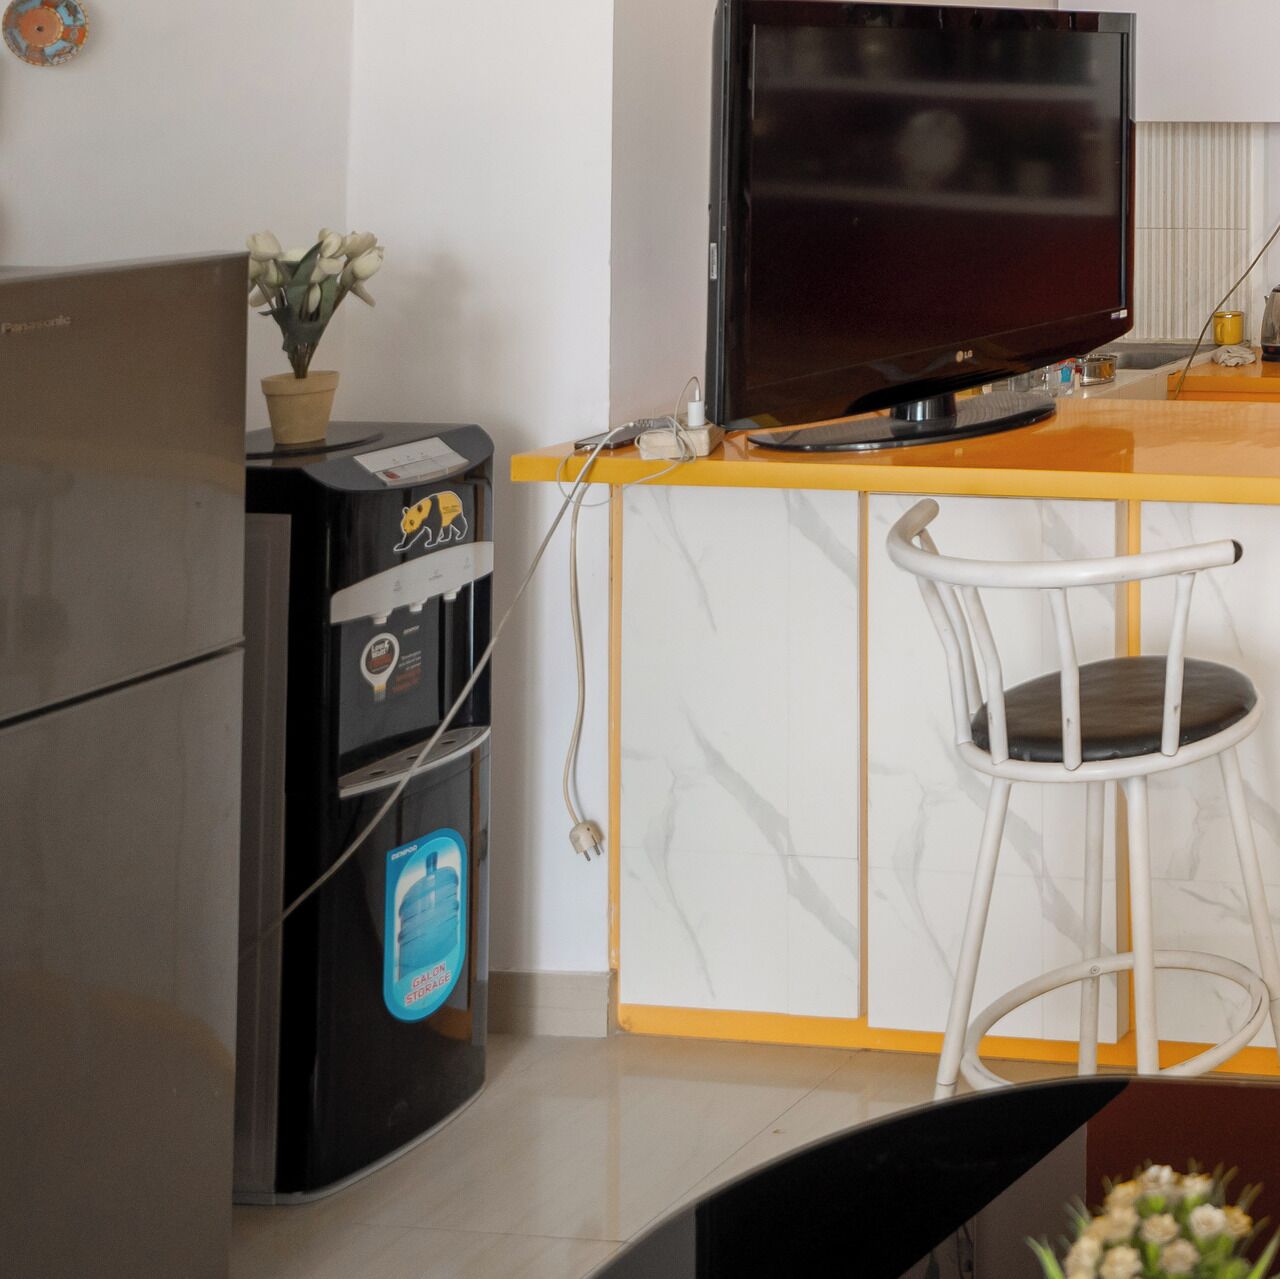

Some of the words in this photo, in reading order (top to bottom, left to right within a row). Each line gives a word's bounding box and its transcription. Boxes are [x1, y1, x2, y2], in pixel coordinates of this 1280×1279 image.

[964, 349, 973, 359] LG
[405, 970, 451, 1008] STORAGE
[412, 960, 447, 989] GALON
